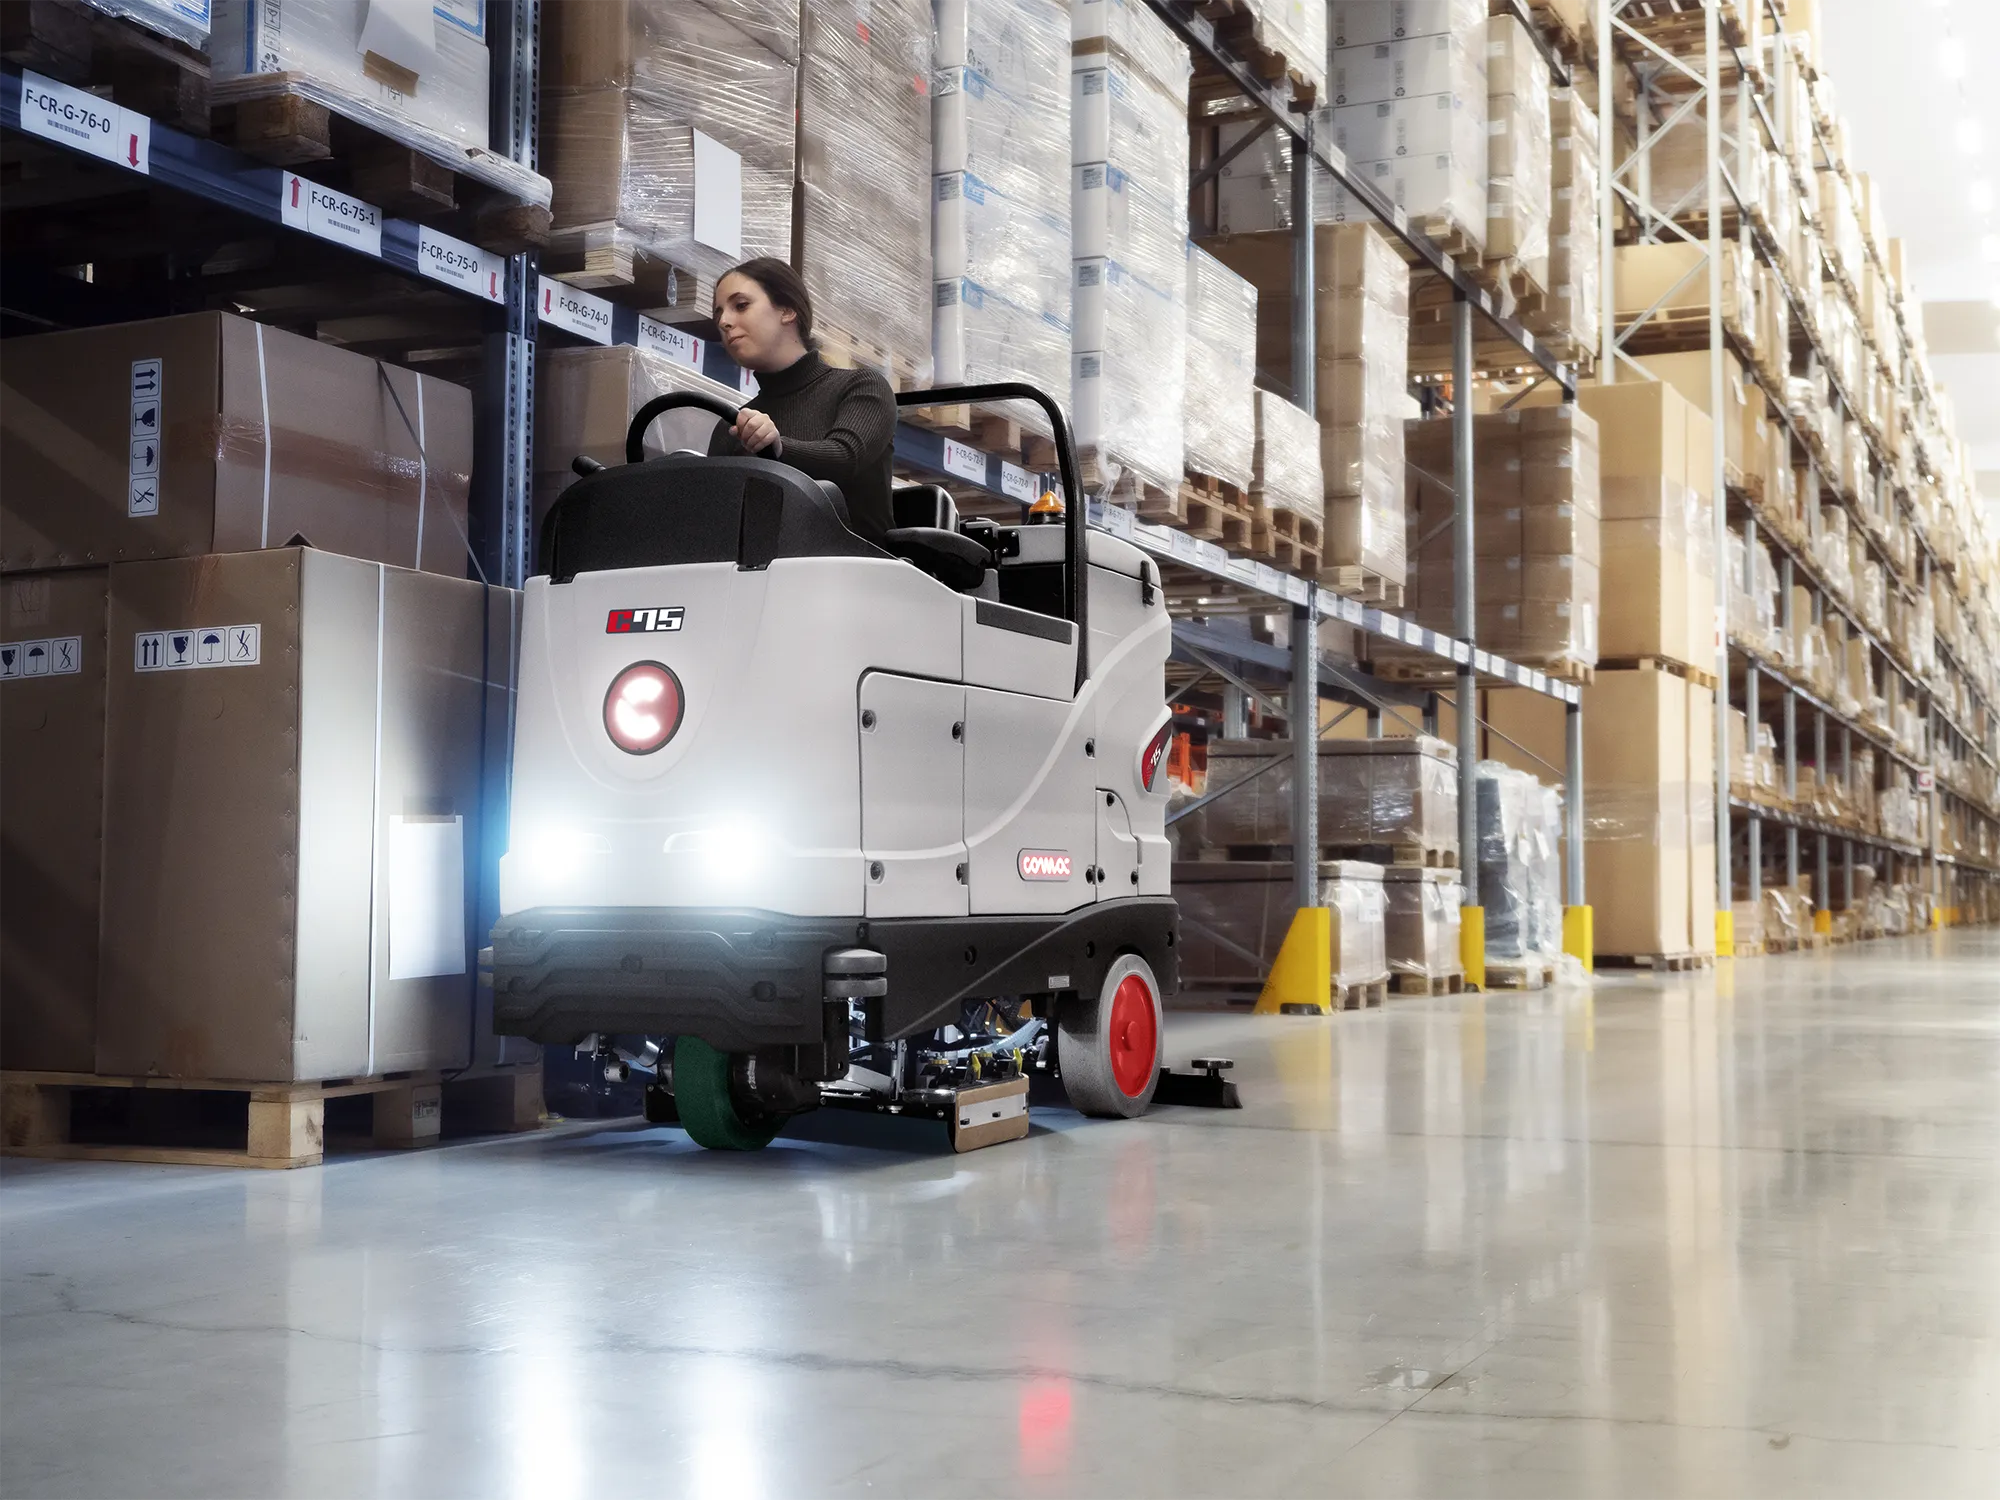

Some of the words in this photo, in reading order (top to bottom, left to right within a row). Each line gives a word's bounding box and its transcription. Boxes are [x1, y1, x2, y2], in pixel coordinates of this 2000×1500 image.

[25, 88, 111, 134] F-CR-G-76-0
[311, 190, 376, 226] F-CR-G-75-1
[420, 241, 478, 273] F-CR-G-75-0
[559, 296, 609, 326] F-CR-G-74-0
[640, 321, 684, 349] F-CR-G-74-1
